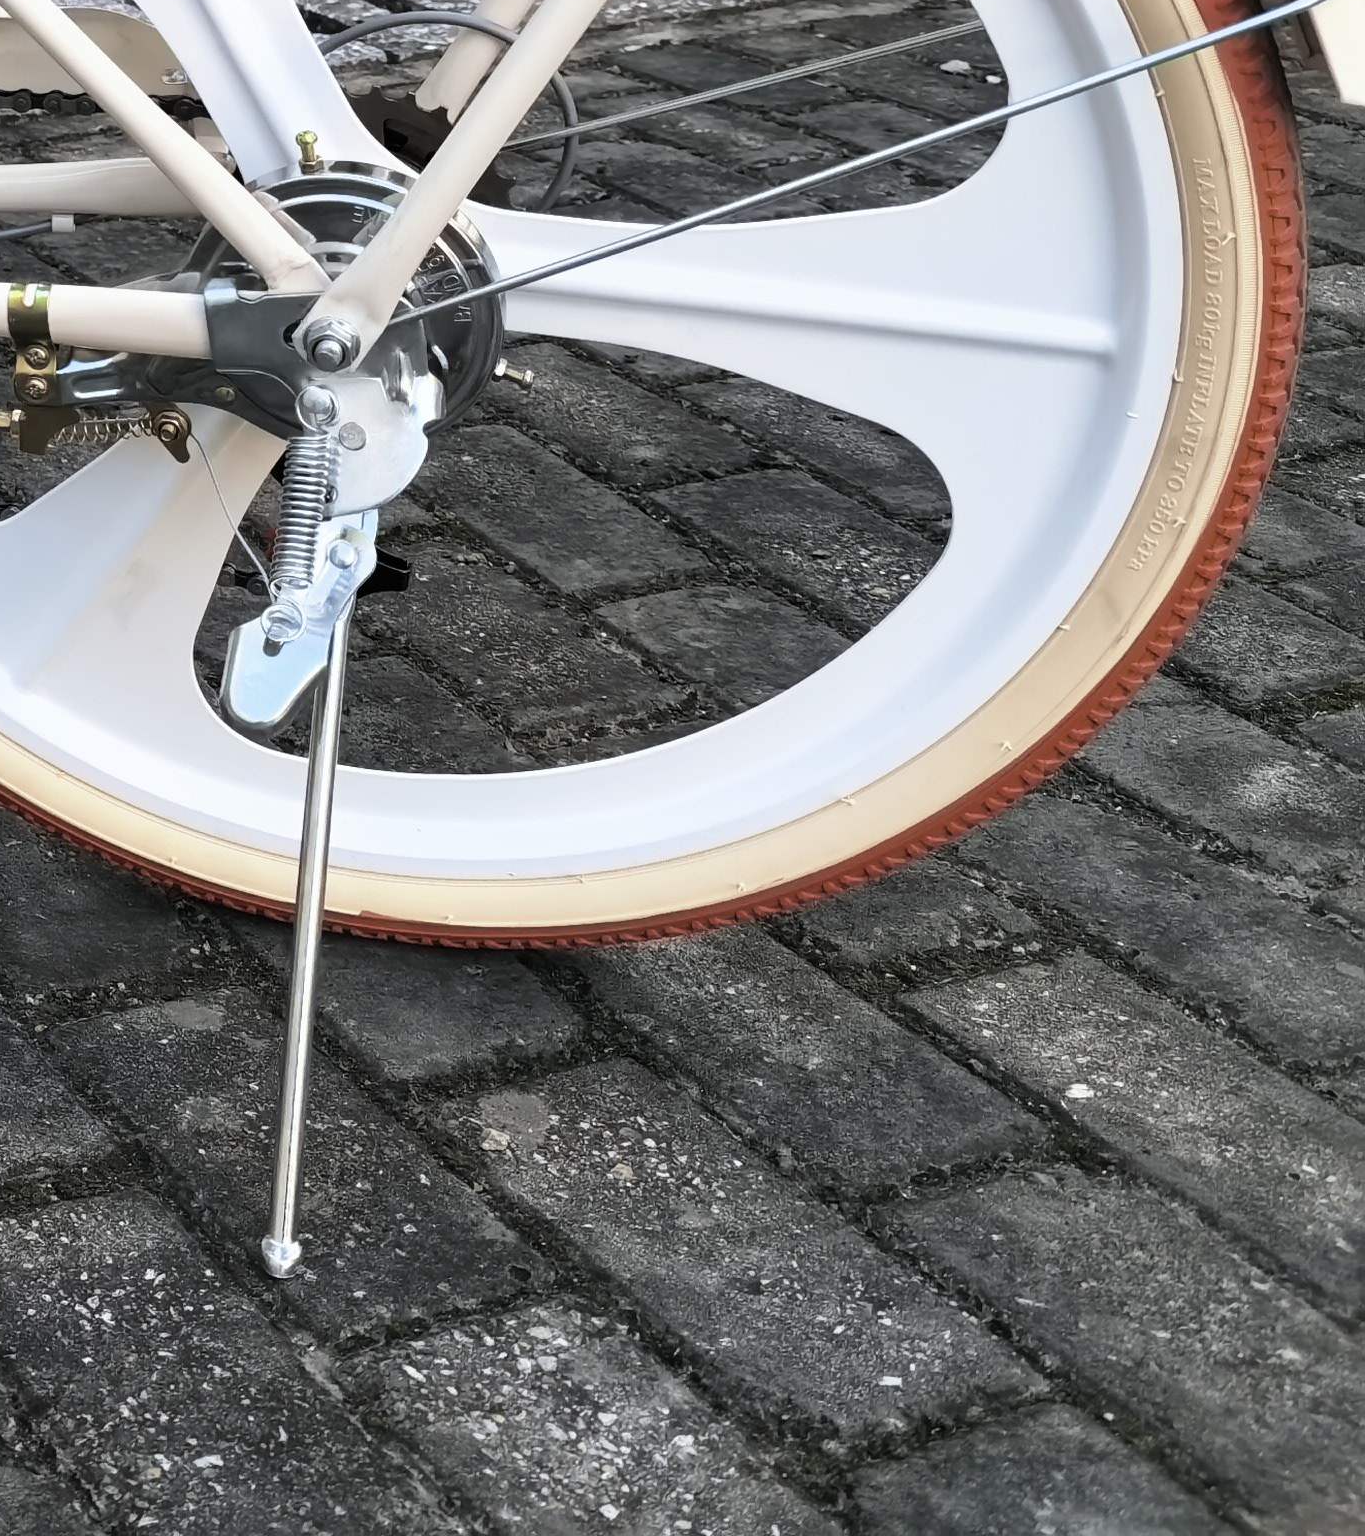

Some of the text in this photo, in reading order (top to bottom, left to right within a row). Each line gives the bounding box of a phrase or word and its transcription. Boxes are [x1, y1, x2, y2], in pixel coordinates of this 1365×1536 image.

[1193, 158, 1219, 214] MAX
[1201, 219, 1224, 287] LOAD
[1178, 354, 1218, 457] INFLATE
[1167, 461, 1193, 494] TO
